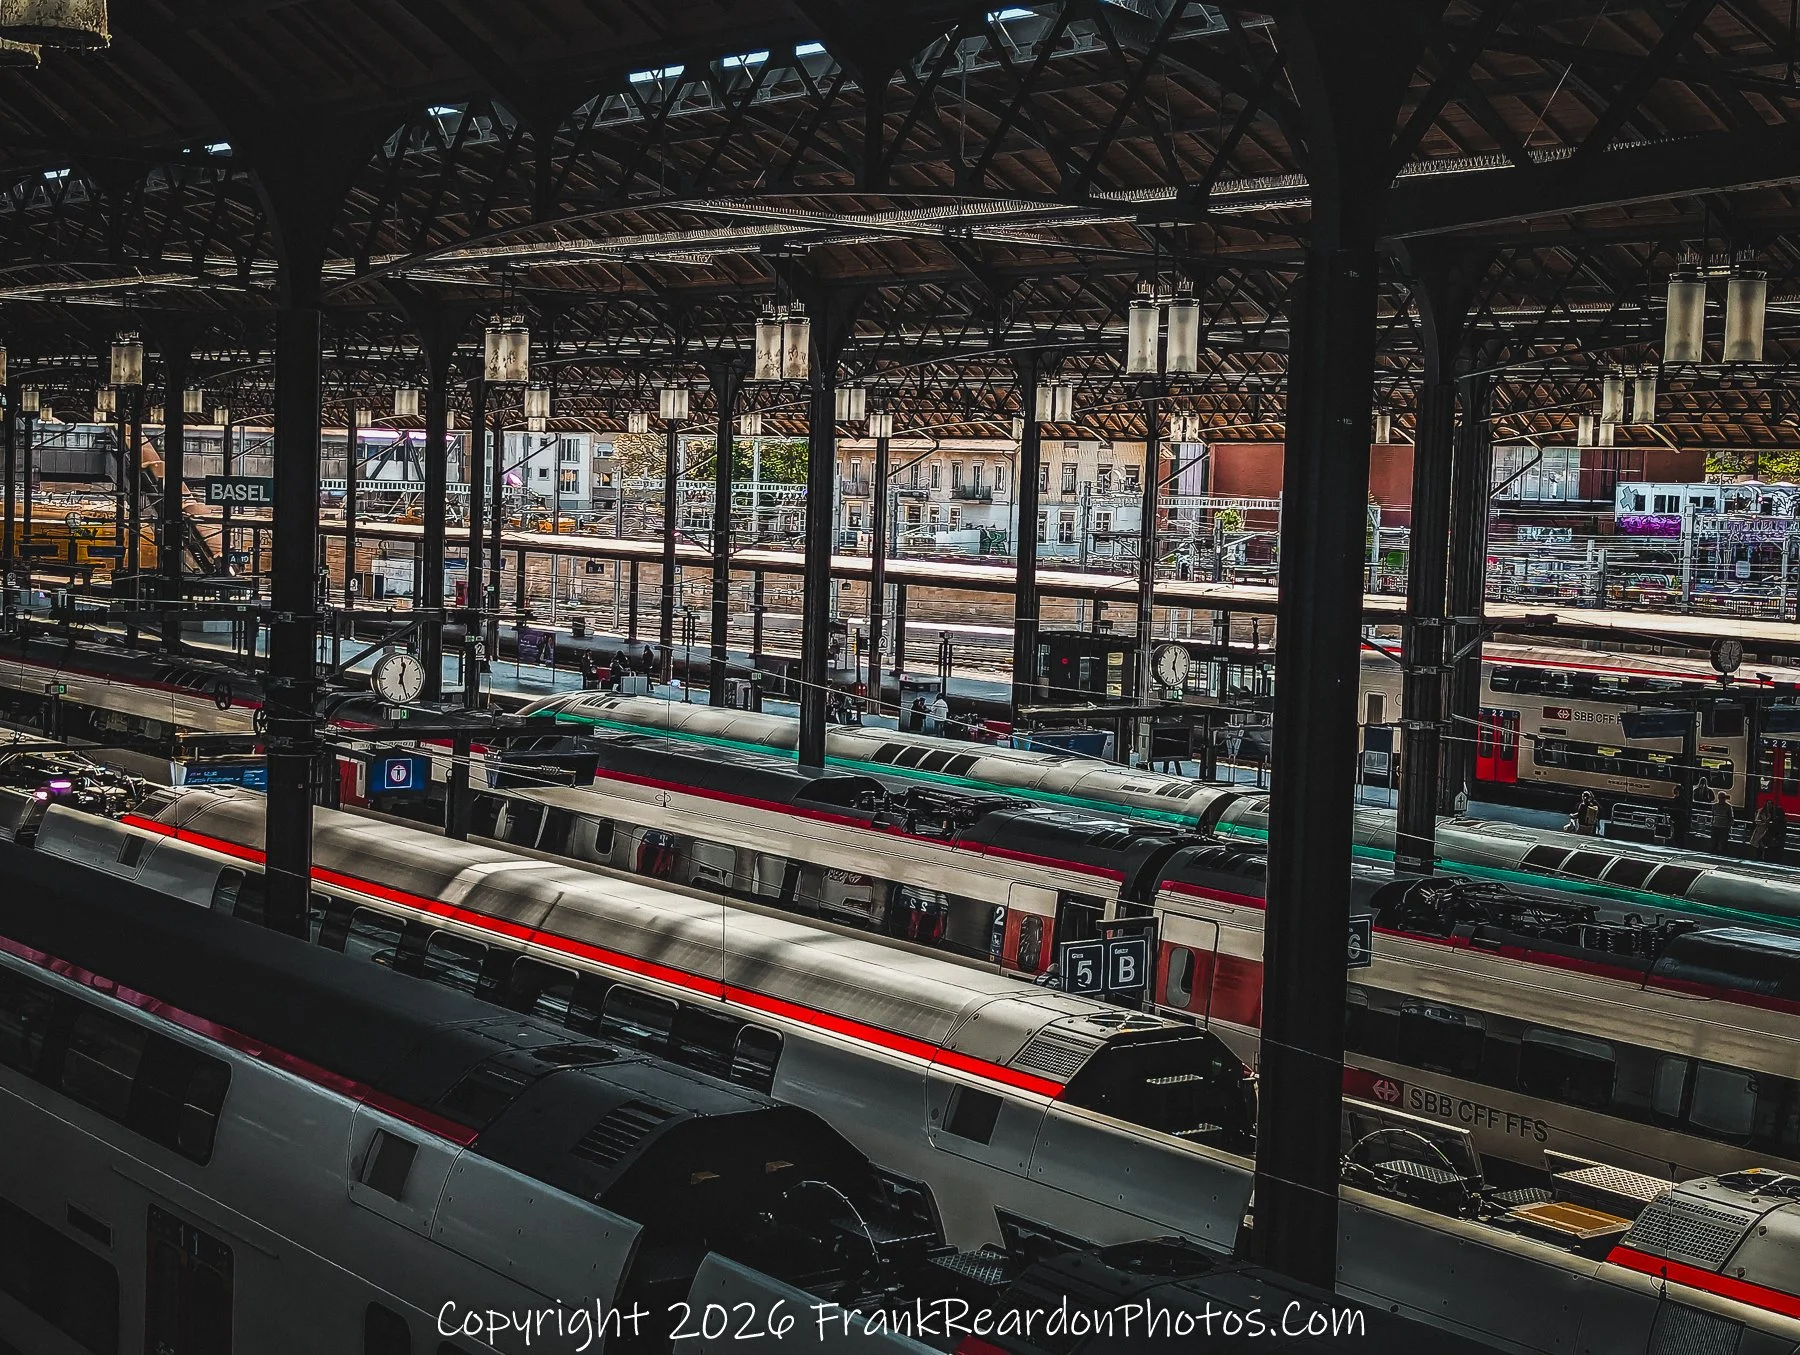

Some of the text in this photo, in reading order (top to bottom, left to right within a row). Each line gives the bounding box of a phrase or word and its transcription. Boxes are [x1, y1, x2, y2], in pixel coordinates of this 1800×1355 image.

[211, 483, 270, 502] BASEL
[1573, 711, 1594, 722] SBB
[1595, 713, 1615, 725] CFF
[994, 906, 1005, 926] 2
[1348, 933, 1361, 959] 6
[1077, 956, 1135, 987] 5 B
[1410, 1088, 1548, 1143] SBB CFF FFS
